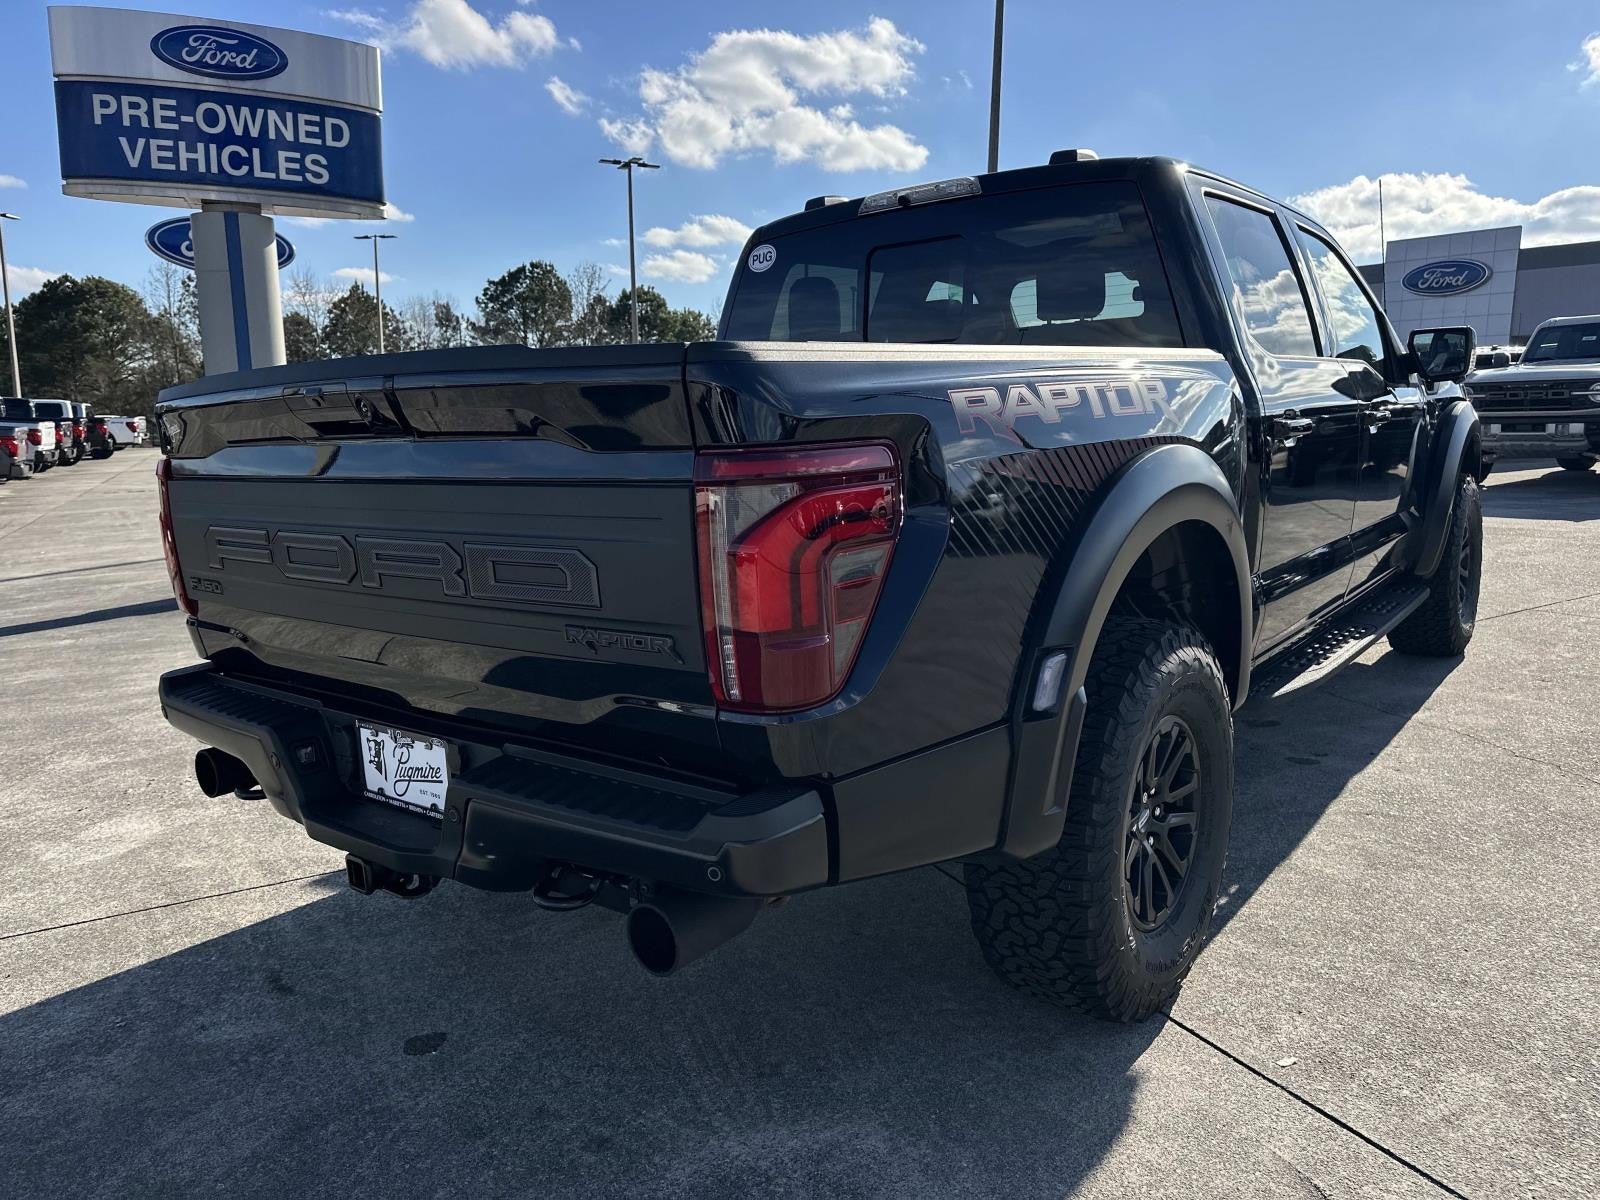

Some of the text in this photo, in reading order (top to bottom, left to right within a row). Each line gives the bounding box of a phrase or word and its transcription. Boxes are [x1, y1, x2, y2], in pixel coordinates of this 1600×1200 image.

[182, 34, 257, 70] Ford
[92, 93, 351, 149] PRE-OWNED
[118, 136, 329, 185] VEHICLES
[752, 250, 773, 266] PUG
[1418, 267, 1468, 289] Ford
[948, 379, 1182, 447] RAPTOR
[1486, 389, 1569, 401] FORD
[205, 525, 601, 608] FORD
[564, 623, 685, 665] RAPTOR
[393, 744, 443, 797] Pugmire
